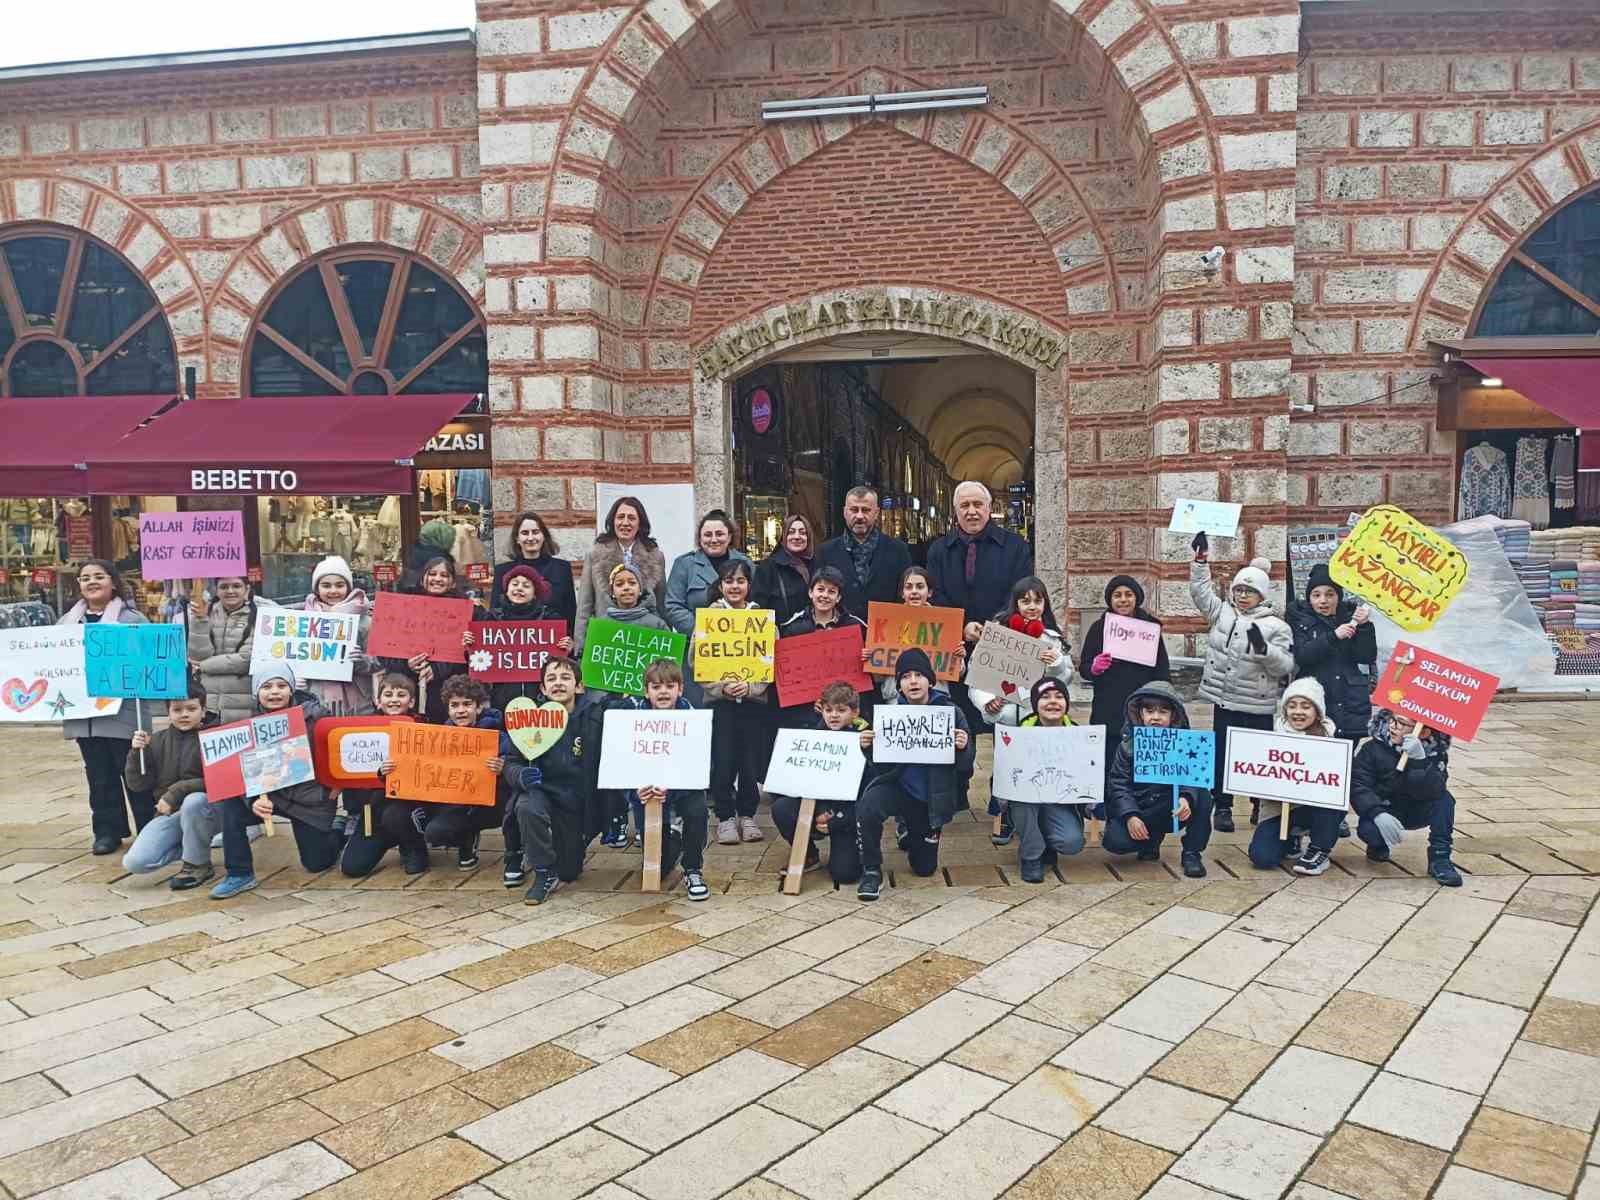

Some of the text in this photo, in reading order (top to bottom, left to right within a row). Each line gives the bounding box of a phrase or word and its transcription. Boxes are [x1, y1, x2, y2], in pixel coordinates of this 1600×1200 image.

[855, 297, 956, 329] KAPALI
[420, 433, 484, 451] AZASI
[191, 469, 297, 491] BEBETTO
[142, 520, 183, 533] ALLAH
[143, 541, 240, 561] RAST GETİRSİN
[1380, 521, 1448, 573] HAYIRLI
[482, 627, 555, 646] HAYIRLI
[705, 616, 768, 635] KOLAY
[873, 618, 944, 646] KLAY
[611, 629, 673, 653] ALLAH
[698, 636, 767, 657] GELSİN
[983, 627, 1041, 661] BEREKETL
[271, 641, 347, 664] OLSUN!
[591, 644, 677, 669] BEREK
[601, 669, 644, 692] VERS
[252, 719, 289, 744] İŞLER
[1135, 728, 1178, 740] ALLAH
[1136, 750, 1168, 761] RAST
[1268, 749, 1305, 766] BOL
[1233, 761, 1340, 786] KAZANÇLAR
